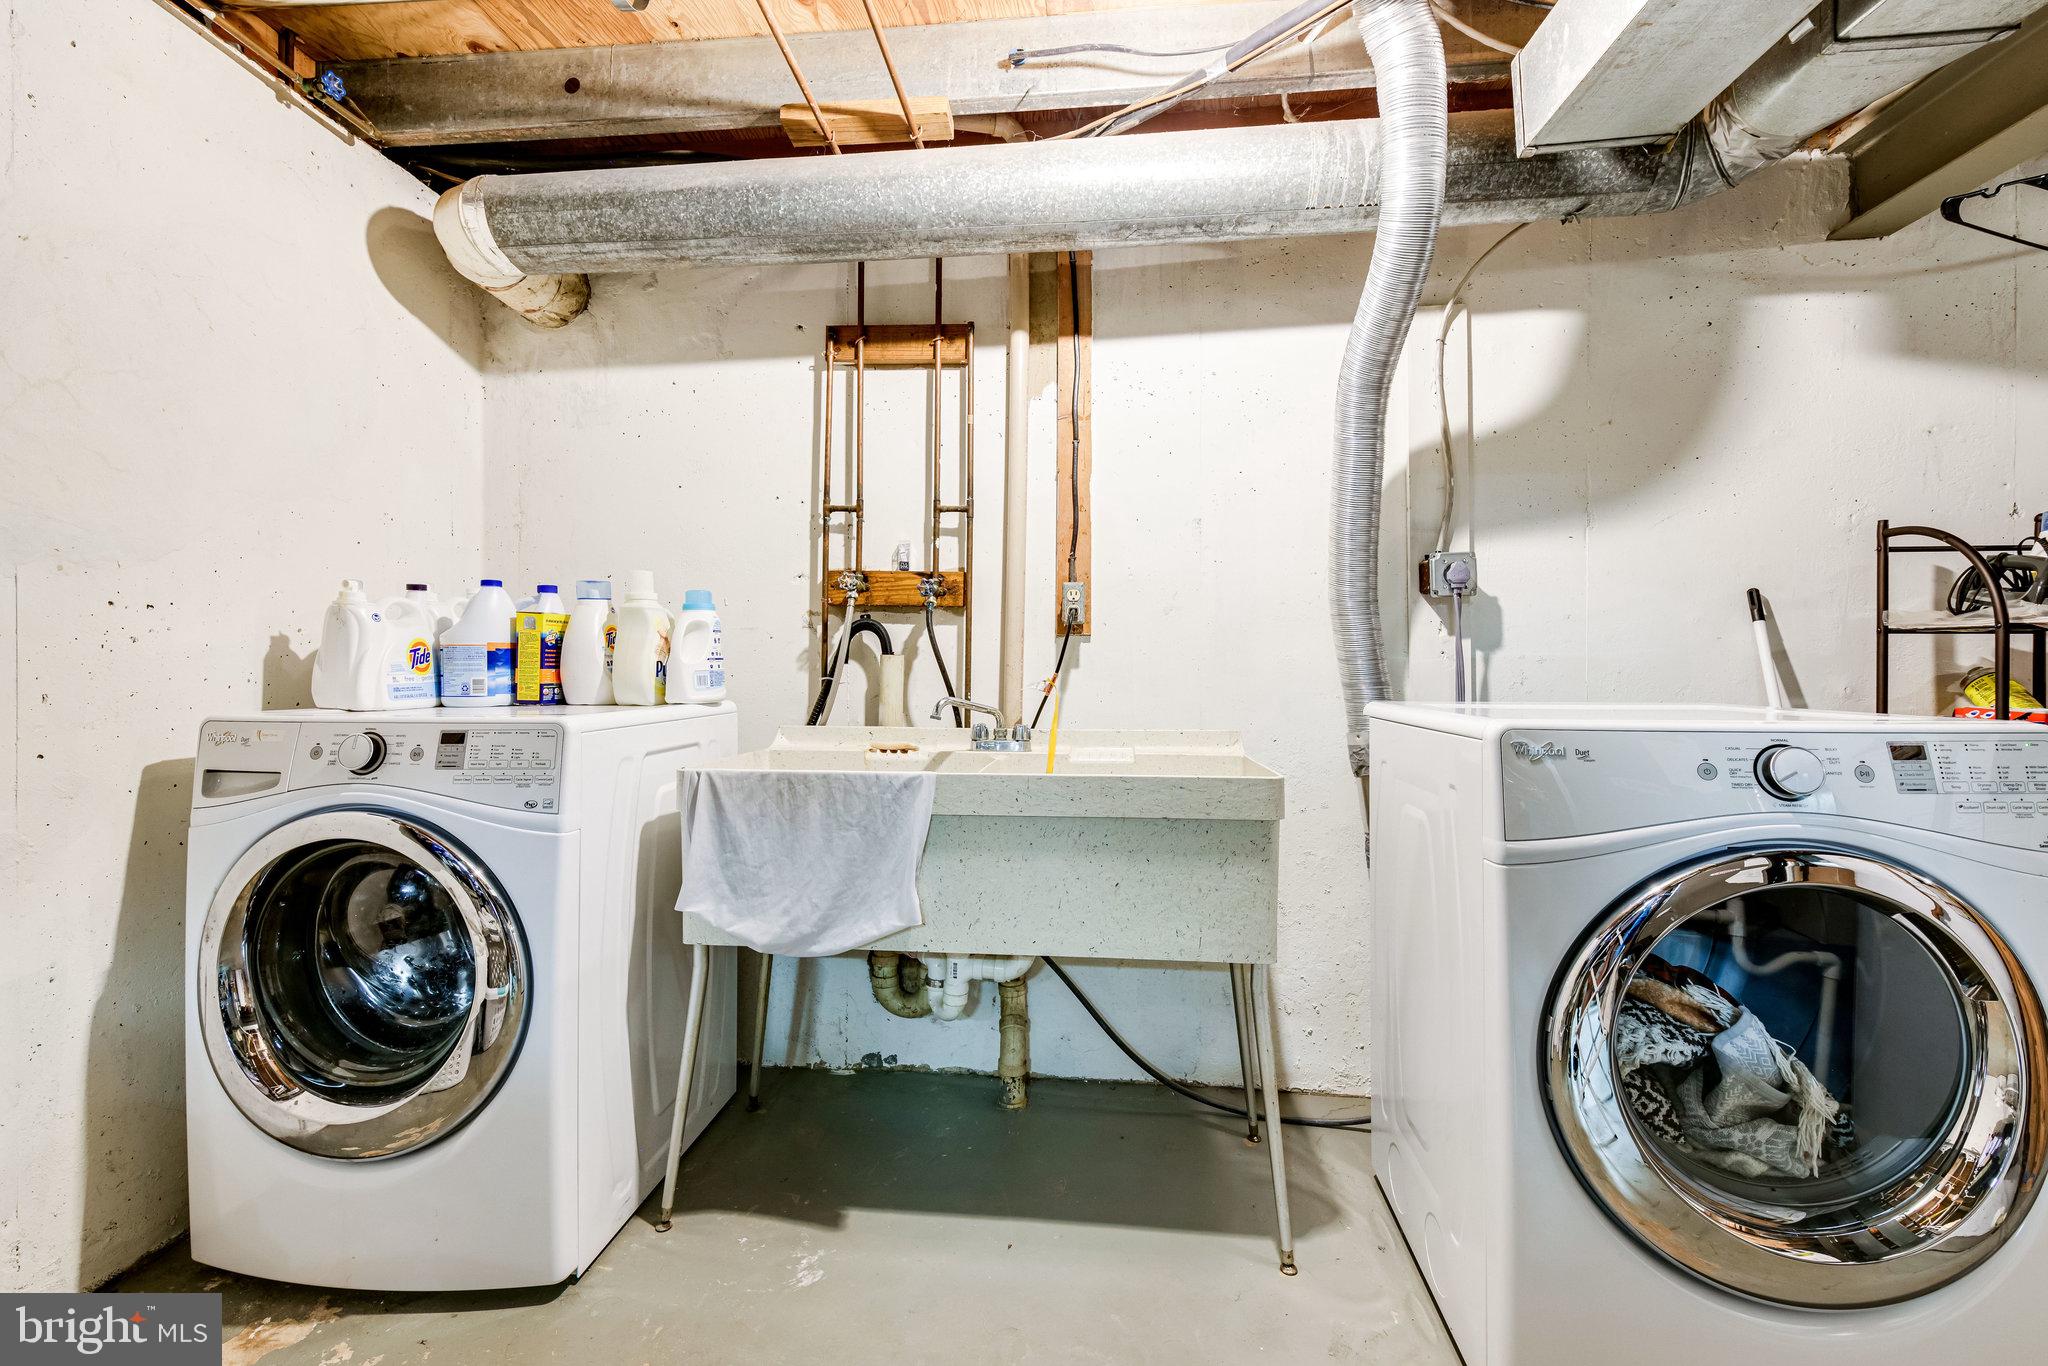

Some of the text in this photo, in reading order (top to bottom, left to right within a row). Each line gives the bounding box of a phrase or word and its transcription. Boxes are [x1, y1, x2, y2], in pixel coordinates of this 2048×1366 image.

[605, 631, 617, 648] Tid
[409, 647, 431, 670] Tide
[656, 660, 667, 677] Pu
[1511, 741, 1567, 761] Whirlpool
[1575, 748, 1590, 756] Duet
